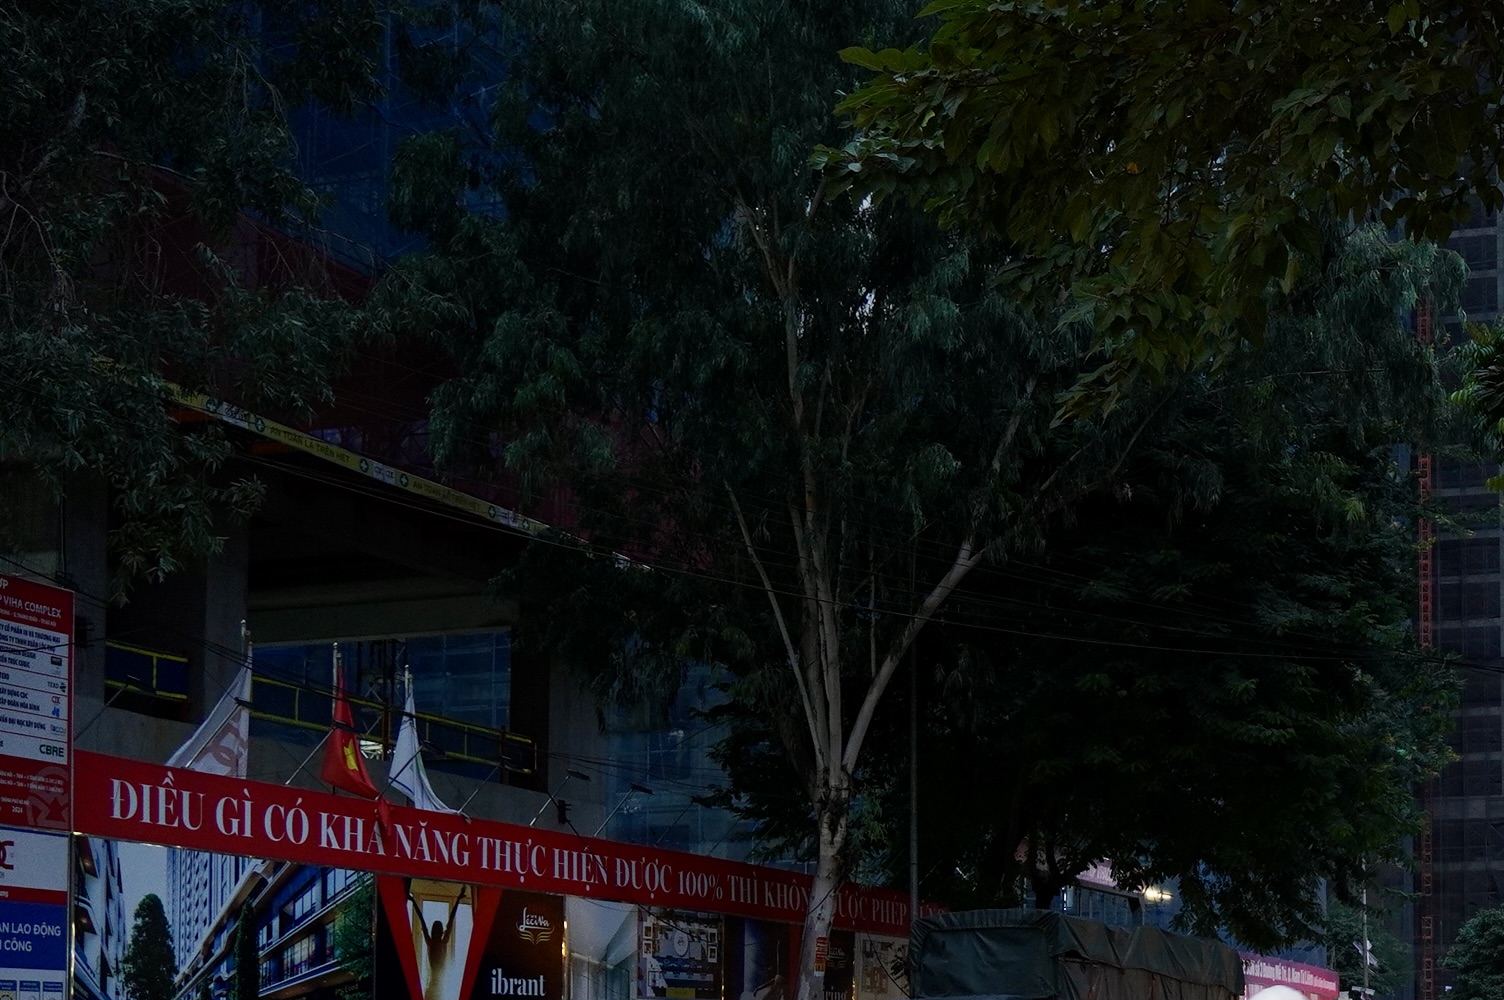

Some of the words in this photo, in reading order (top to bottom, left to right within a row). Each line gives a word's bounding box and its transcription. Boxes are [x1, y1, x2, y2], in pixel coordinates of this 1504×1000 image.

[24, 601, 62, 618] COMPLEX
[39, 744, 64, 757] CBRE
[110, 771, 205, 831] ĐIỀU
[215, 788, 254, 838] GÌ
[264, 797, 310, 845] CÓ
[394, 820, 471, 867] NĂNG
[477, 836, 546, 884] THỰC
[553, 845, 608, 892] HIỆN
[615, 857, 673, 899] ĐƯỢC
[678, 871, 723, 901] 100%
[727, 870, 759, 905] THÌ
[764, 878, 809, 914] KHÔN
[838, 889, 868, 925] ƯỢC
[872, 895, 907, 926] PHÉP
[11, 922, 31, 934] LAO
[33, 921, 61, 939] ĐỘNG
[4, 936, 32, 952] CÔNG
[491, 967, 546, 996] ibrant
